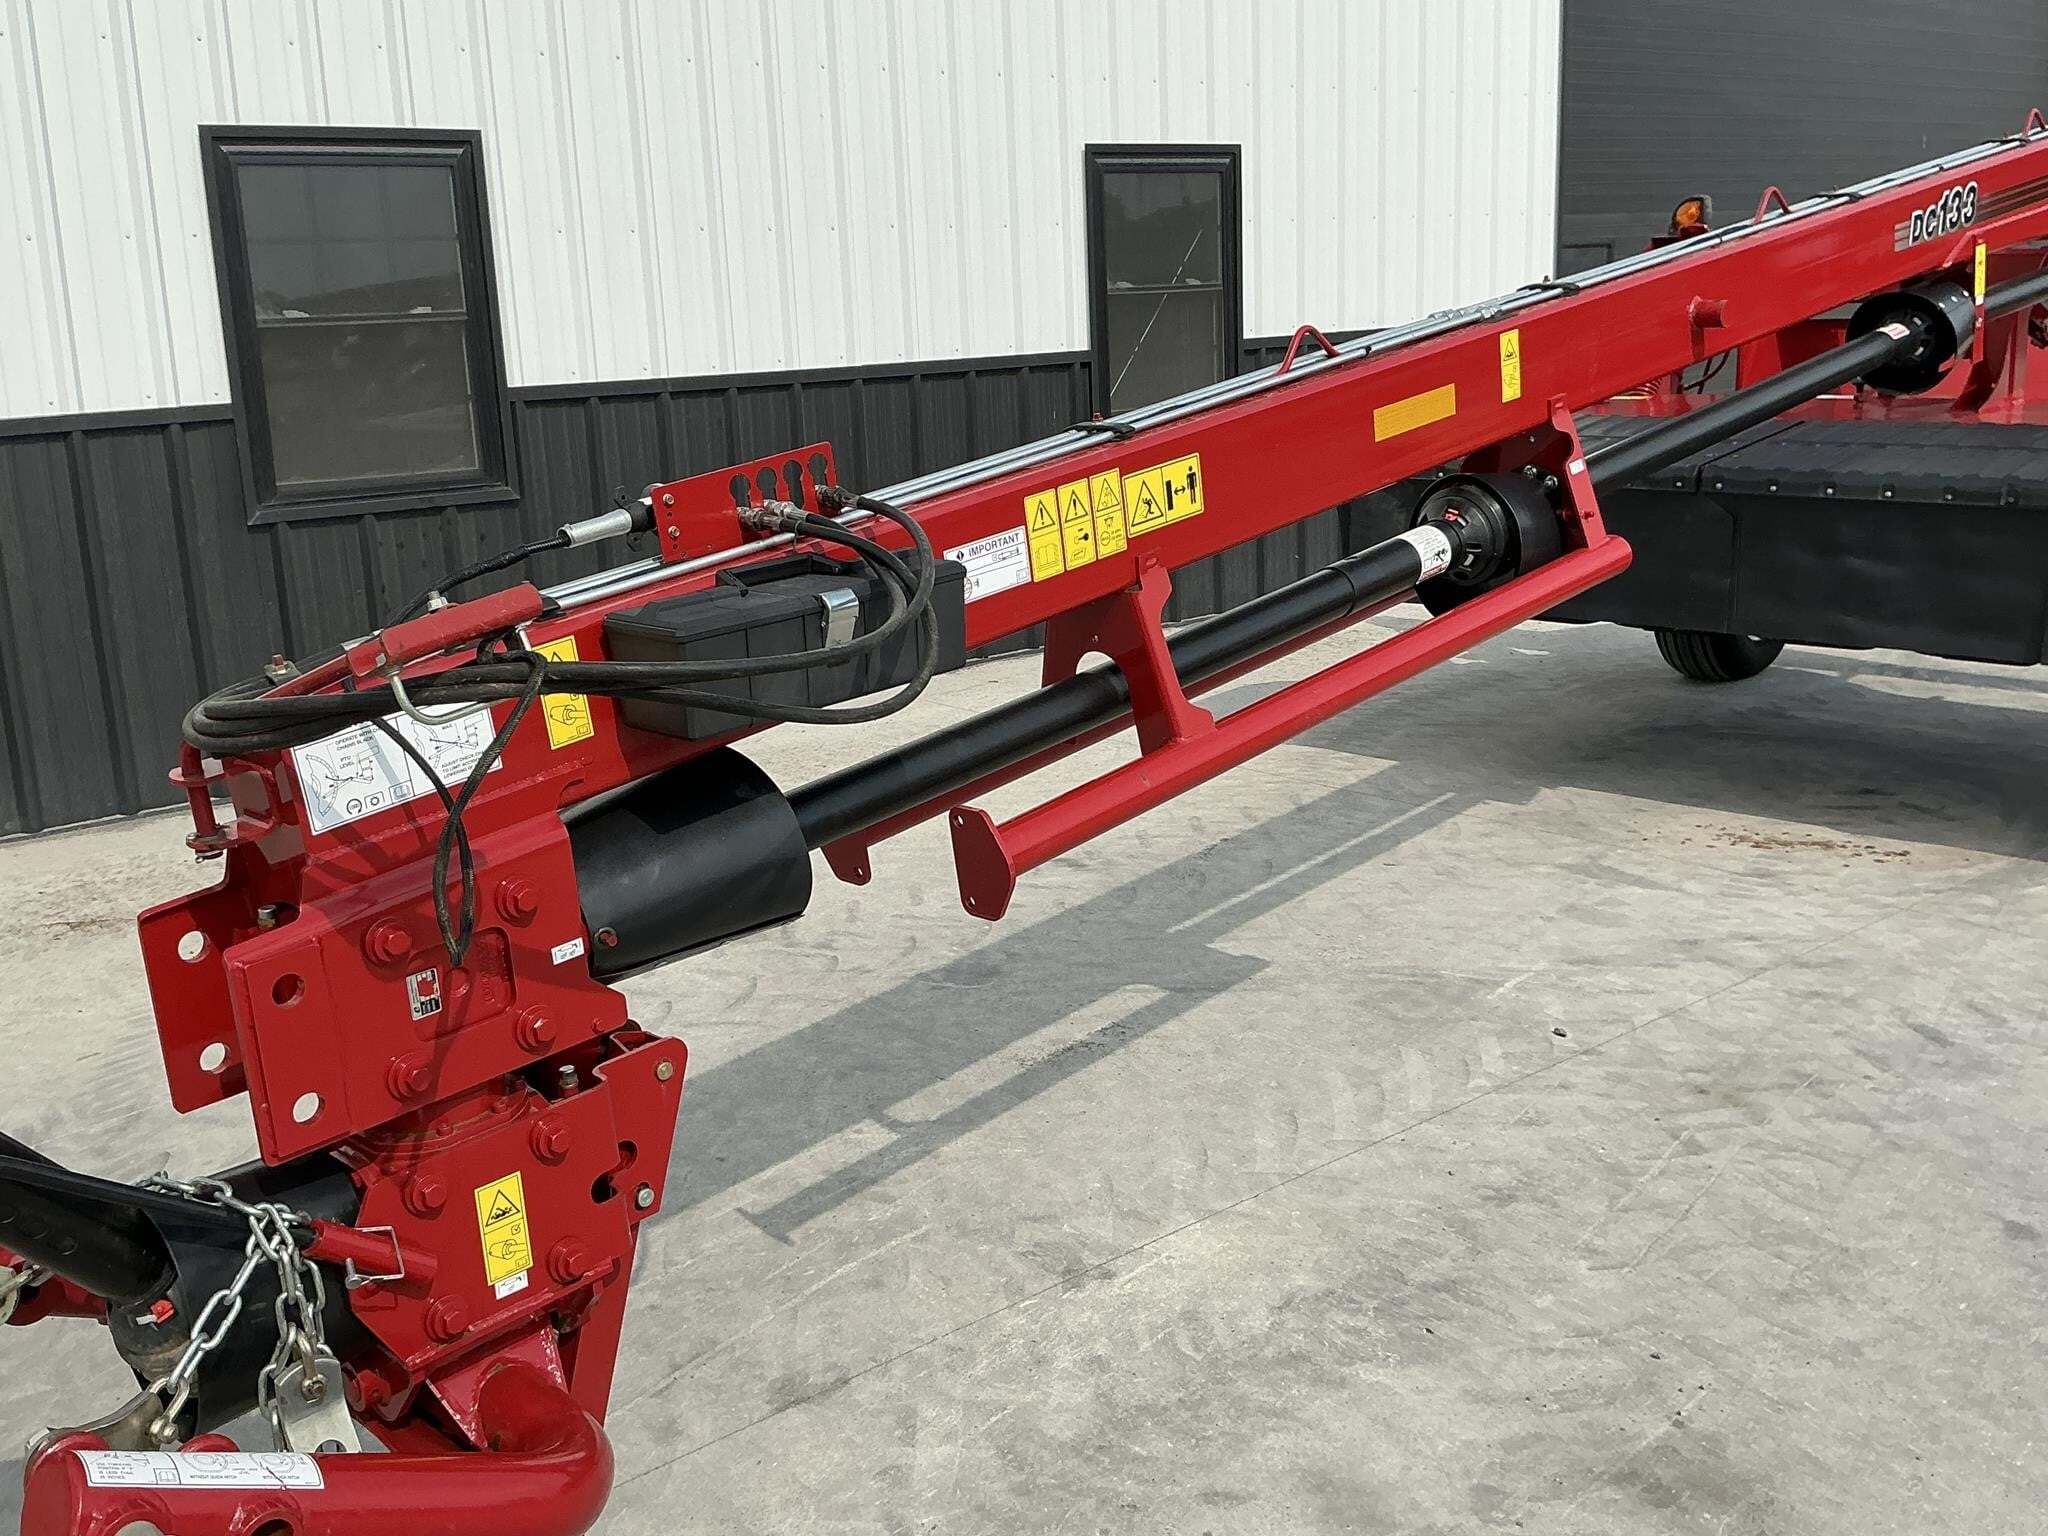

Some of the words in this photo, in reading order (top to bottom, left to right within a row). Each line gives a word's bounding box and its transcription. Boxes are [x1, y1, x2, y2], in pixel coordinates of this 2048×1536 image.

[1908, 181, 1977, 247] DC133
[968, 533, 1020, 558] IMPORTANT
[335, 734, 358, 745] OPERATE
[339, 761, 355, 769] LEVEL
